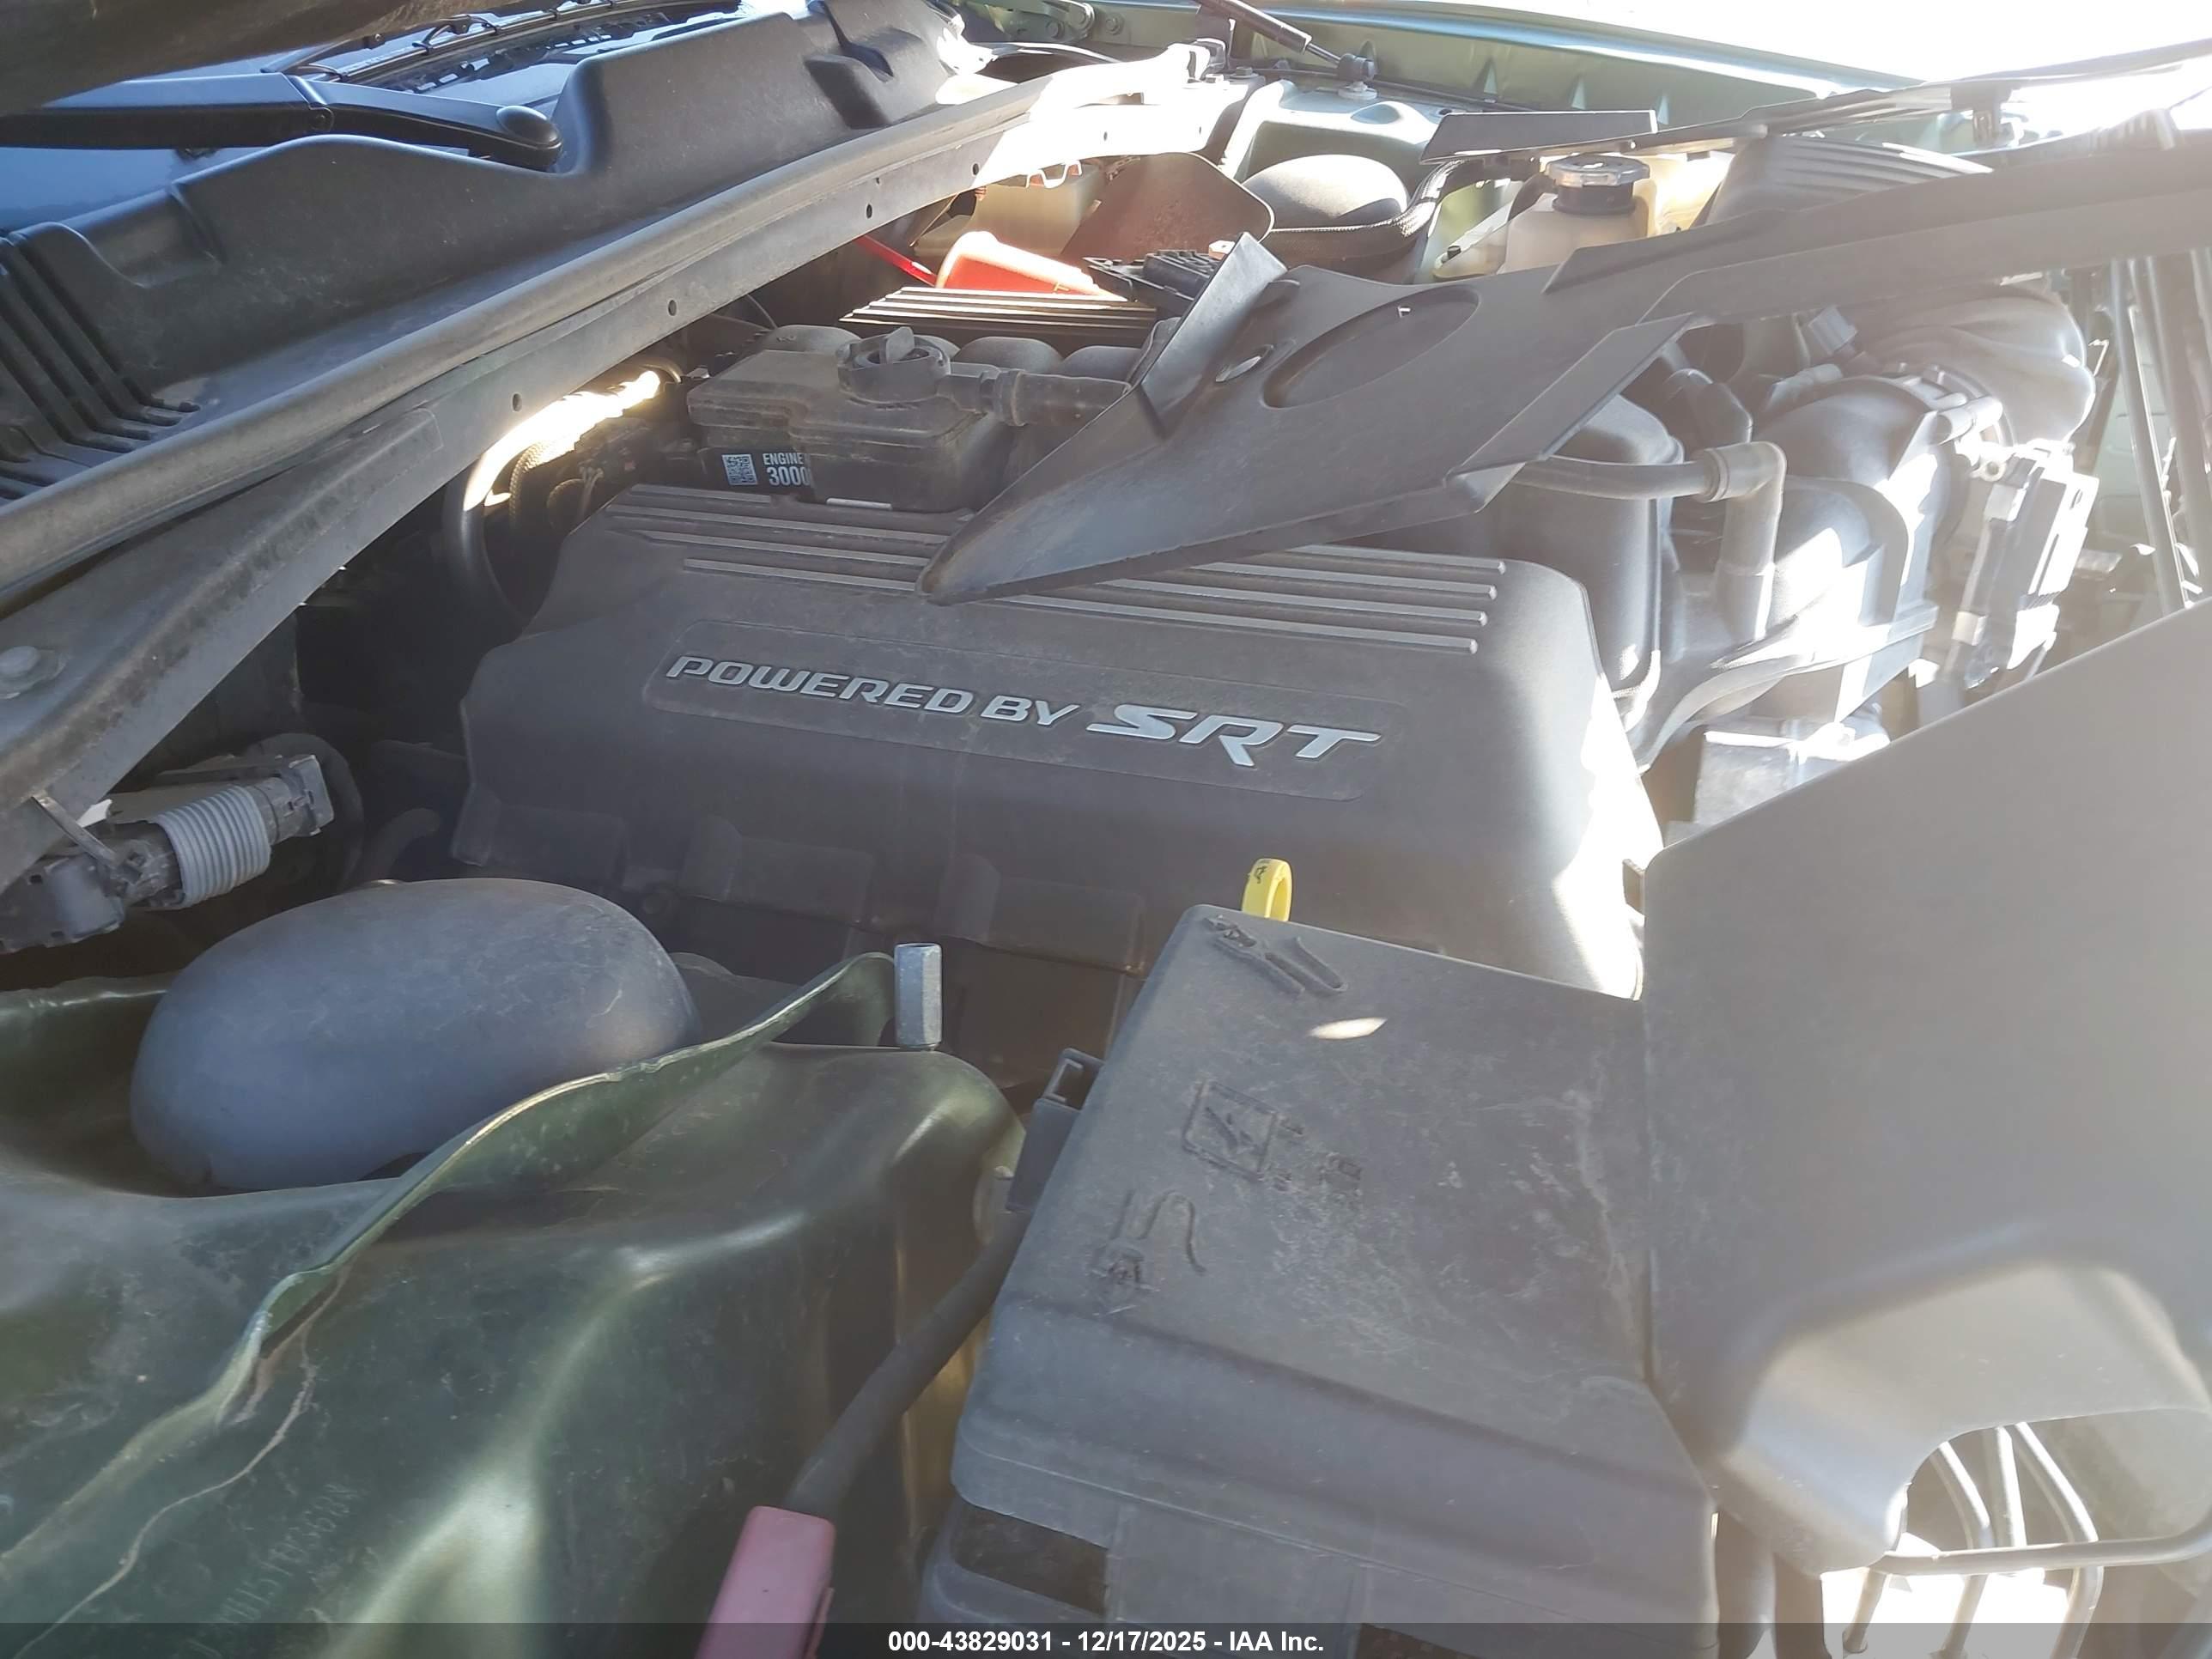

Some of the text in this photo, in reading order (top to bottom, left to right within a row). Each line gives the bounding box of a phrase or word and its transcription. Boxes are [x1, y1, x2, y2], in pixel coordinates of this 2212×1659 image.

[763, 453, 803, 465] ENGINE
[665, 655, 1381, 767] POWERED BY SRT
